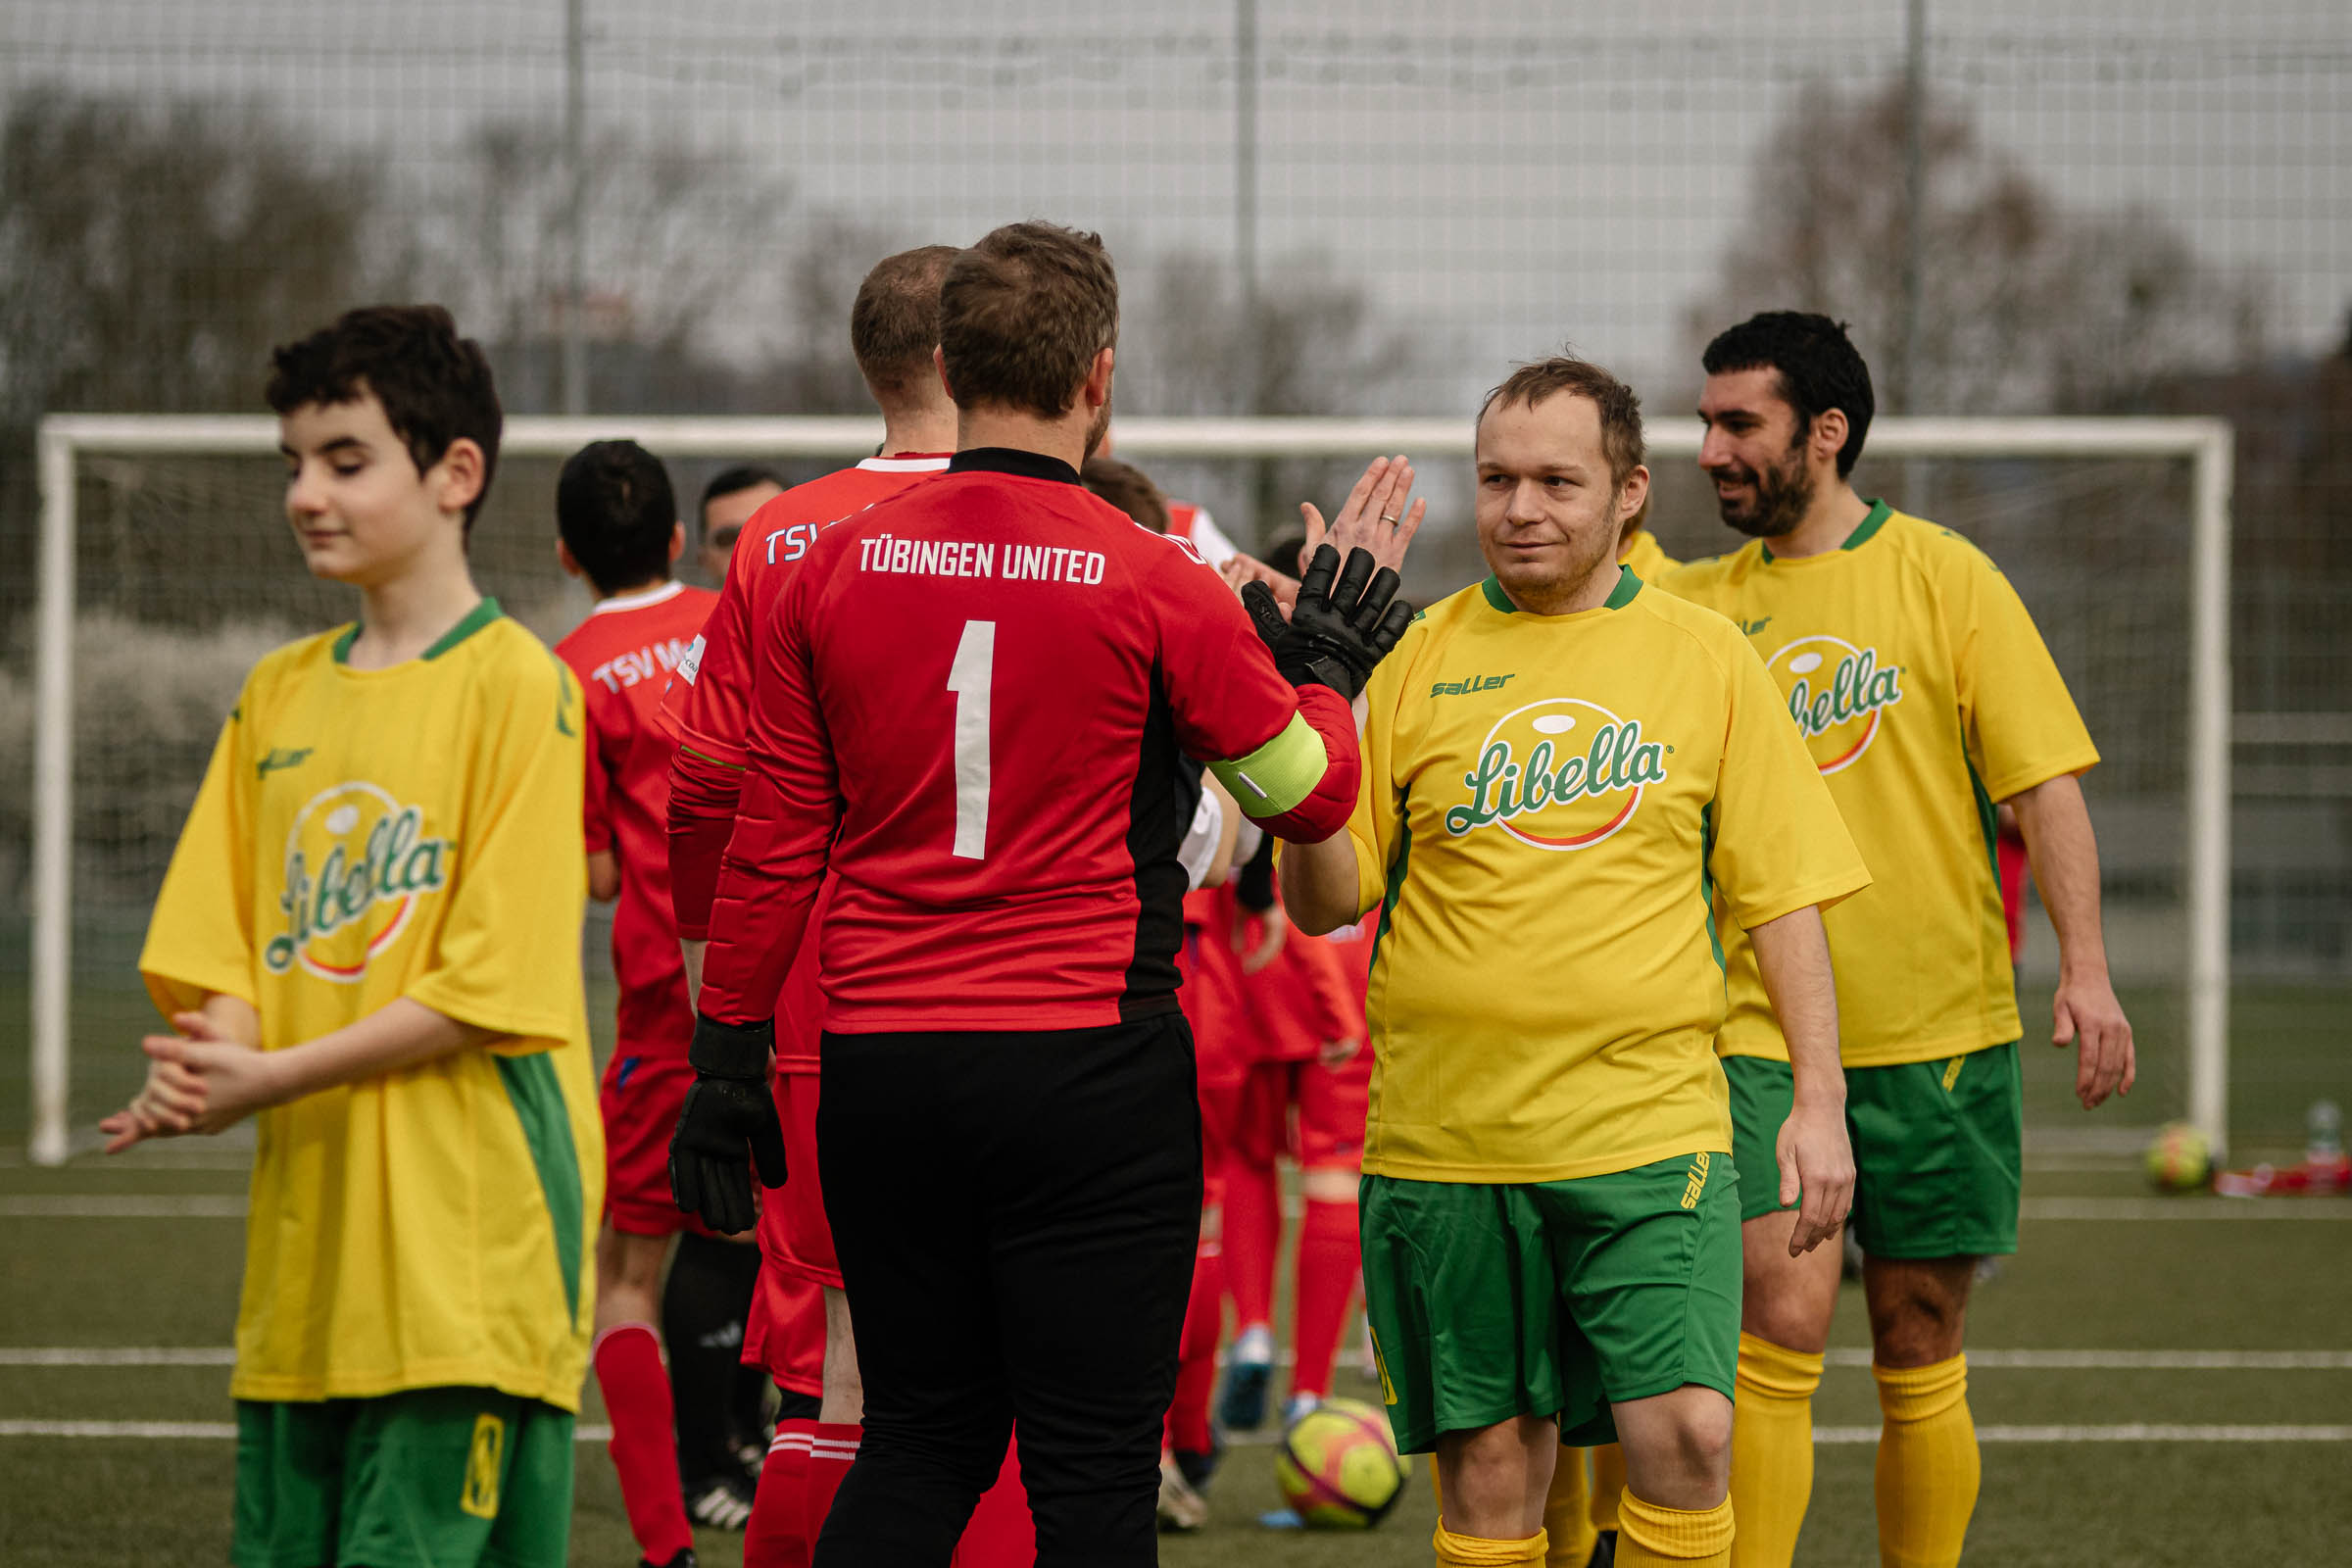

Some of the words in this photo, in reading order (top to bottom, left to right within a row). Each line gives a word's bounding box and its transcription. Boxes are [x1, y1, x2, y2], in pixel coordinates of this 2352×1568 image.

[860, 534, 995, 578] TÜBINGEN
[1003, 544, 1105, 585] UNITED
[591, 646, 655, 694] TSV
[1788, 647, 1902, 737] bella
[947, 619, 996, 860] 1
[1445, 719, 1667, 837] Libella
[1680, 1152, 1710, 1209] salle
